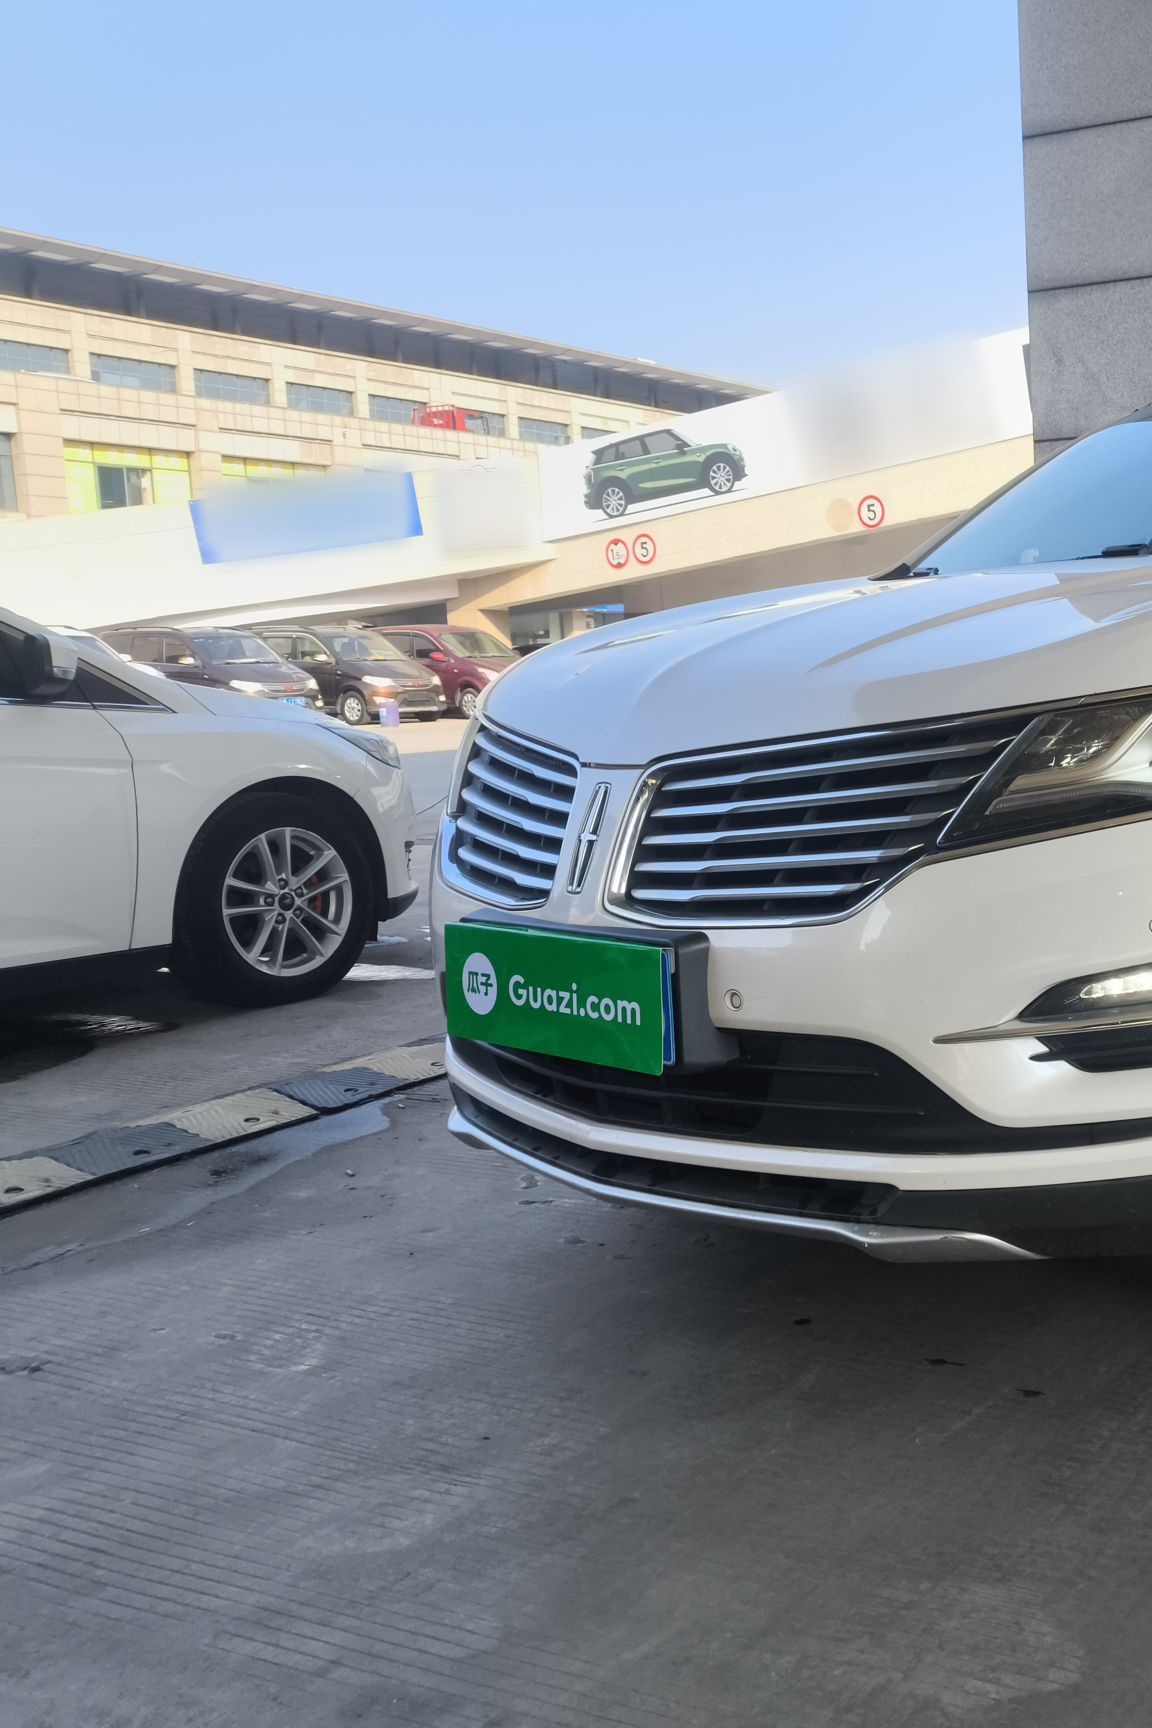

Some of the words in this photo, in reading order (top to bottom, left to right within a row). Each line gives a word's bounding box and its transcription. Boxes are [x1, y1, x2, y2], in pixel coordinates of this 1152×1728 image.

[867, 503, 877, 521] 5
[640, 541, 649, 558] 5
[467, 970, 493, 997] 瓜子
[508, 974, 641, 1026] Guazi.com
